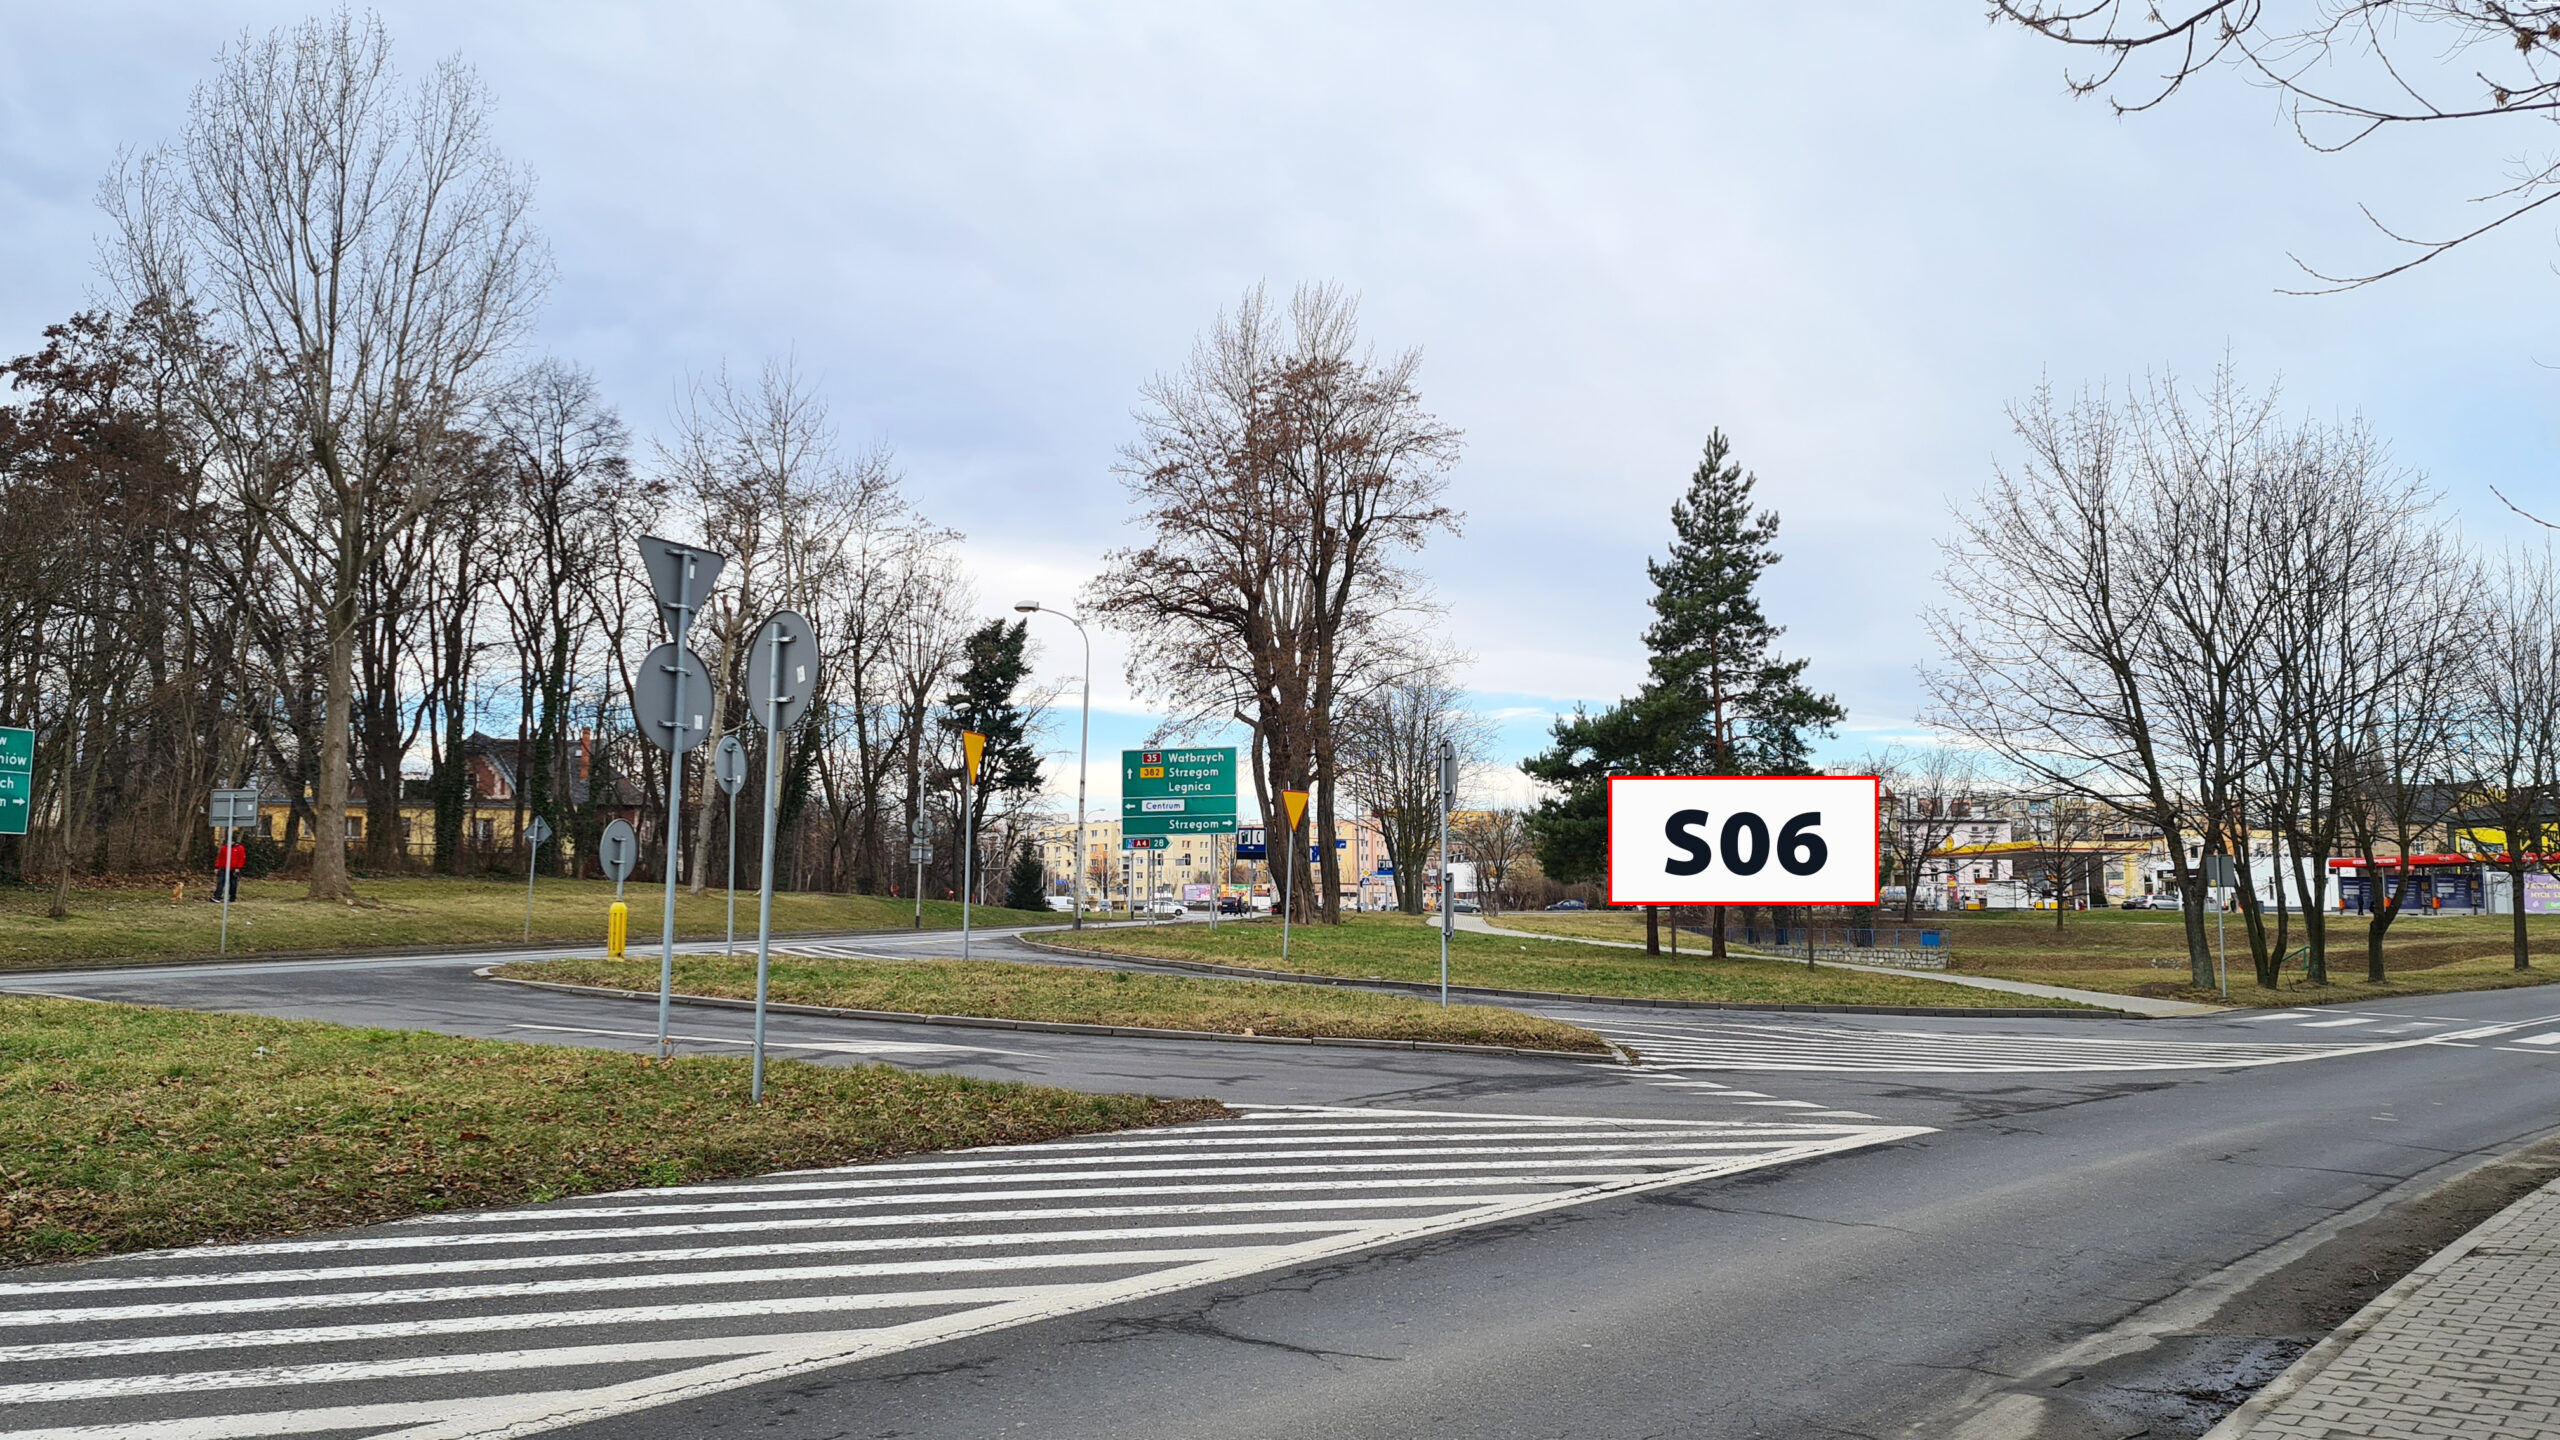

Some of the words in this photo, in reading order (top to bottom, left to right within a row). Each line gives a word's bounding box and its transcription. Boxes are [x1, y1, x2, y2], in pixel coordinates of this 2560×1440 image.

[1147, 754, 1158, 762] 35
[1168, 752, 1224, 764] Wałbrzych
[1144, 768, 1160, 776] 382
[1169, 767, 1219, 779] Strzegom
[1168, 781, 1211, 794] Legnica
[1145, 801, 1181, 810] Centrum
[1169, 820, 1219, 831] Strzegom
[1154, 839, 1164, 847] 28
